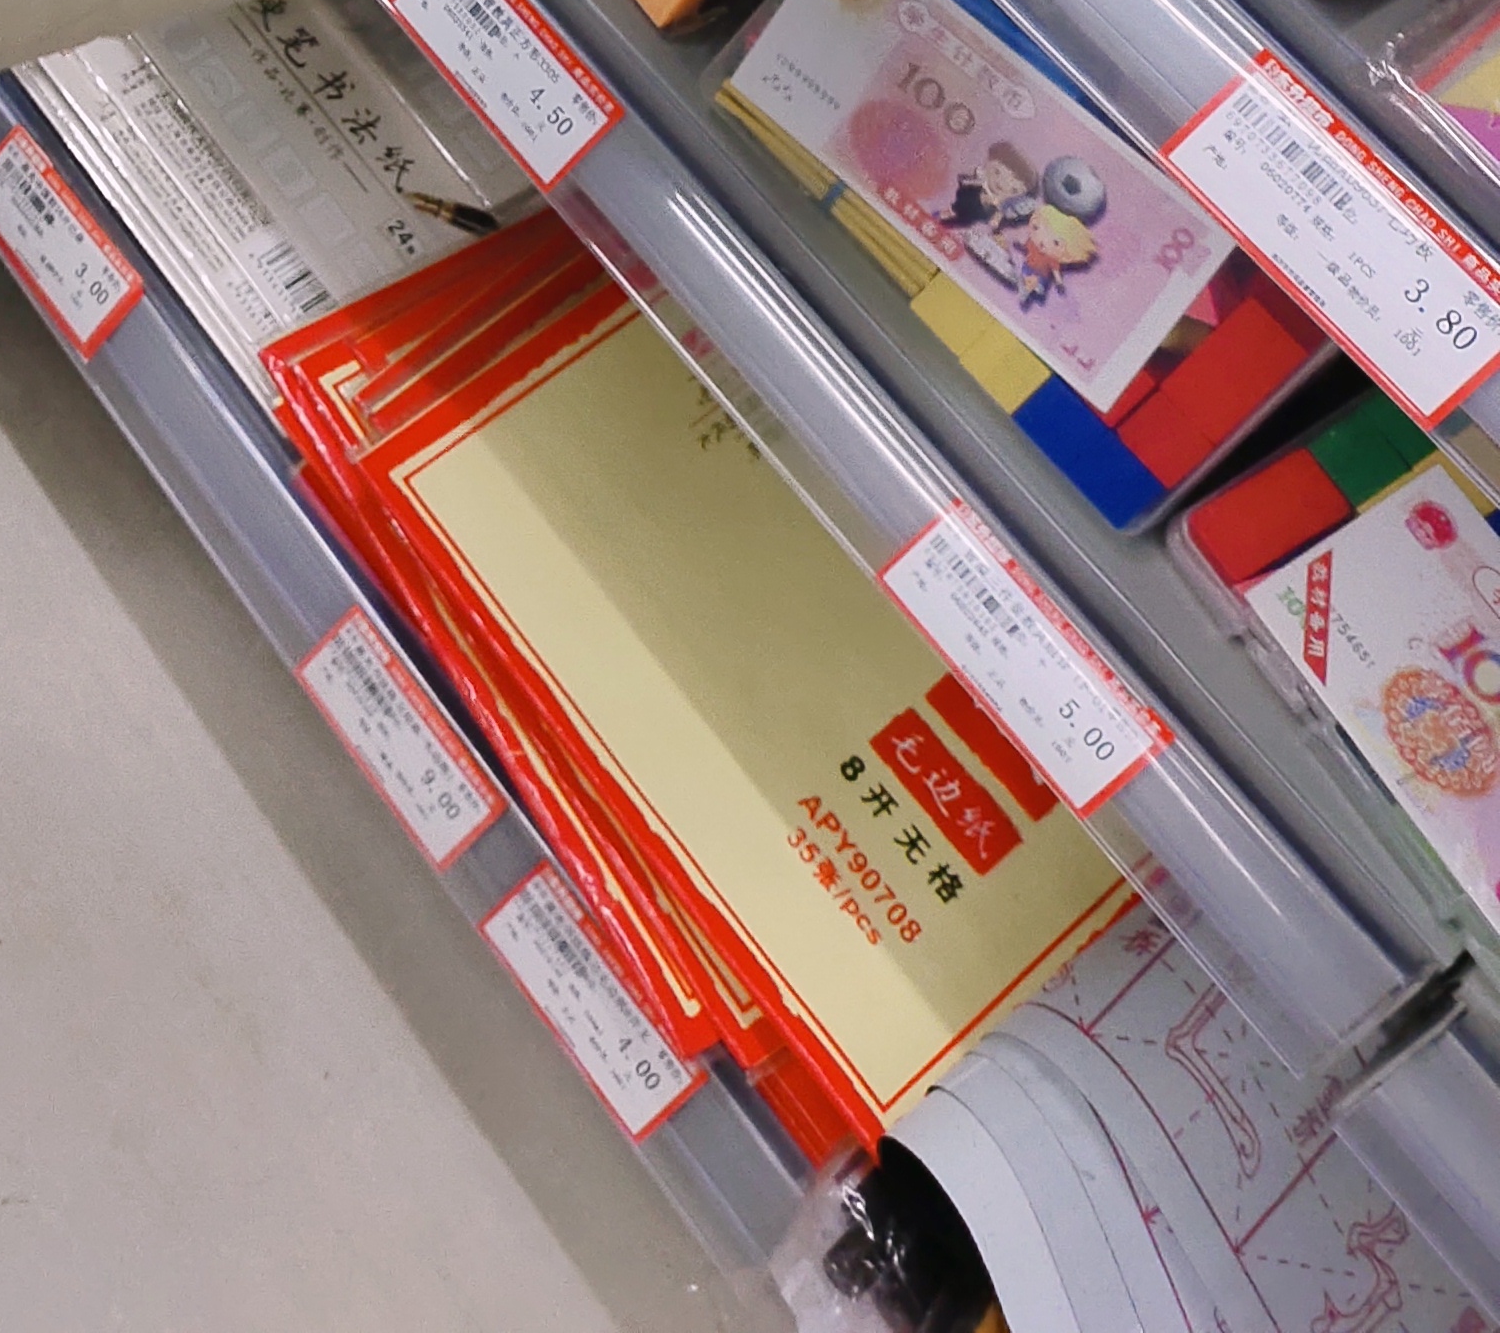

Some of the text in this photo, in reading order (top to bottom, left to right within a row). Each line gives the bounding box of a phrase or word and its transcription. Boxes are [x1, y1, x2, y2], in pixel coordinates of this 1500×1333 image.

[525, 81, 577, 140] 4.50
[889, 57, 984, 142] 100
[1331, 129, 1369, 164] DONG
[1362, 159, 1407, 201] SHENG
[1400, 195, 1439, 232] CHAO
[1432, 226, 1463, 255] SHI
[73, 258, 111, 309] 3.00
[1401, 274, 1484, 354] 3.80
[1054, 695, 1119, 764] 5.00
[418, 766, 463, 824] 9.00
[884, 719, 1011, 865] 毛边纸
[782, 823, 890, 951] 35张/pcs
[795, 788, 926, 946] APY90708
